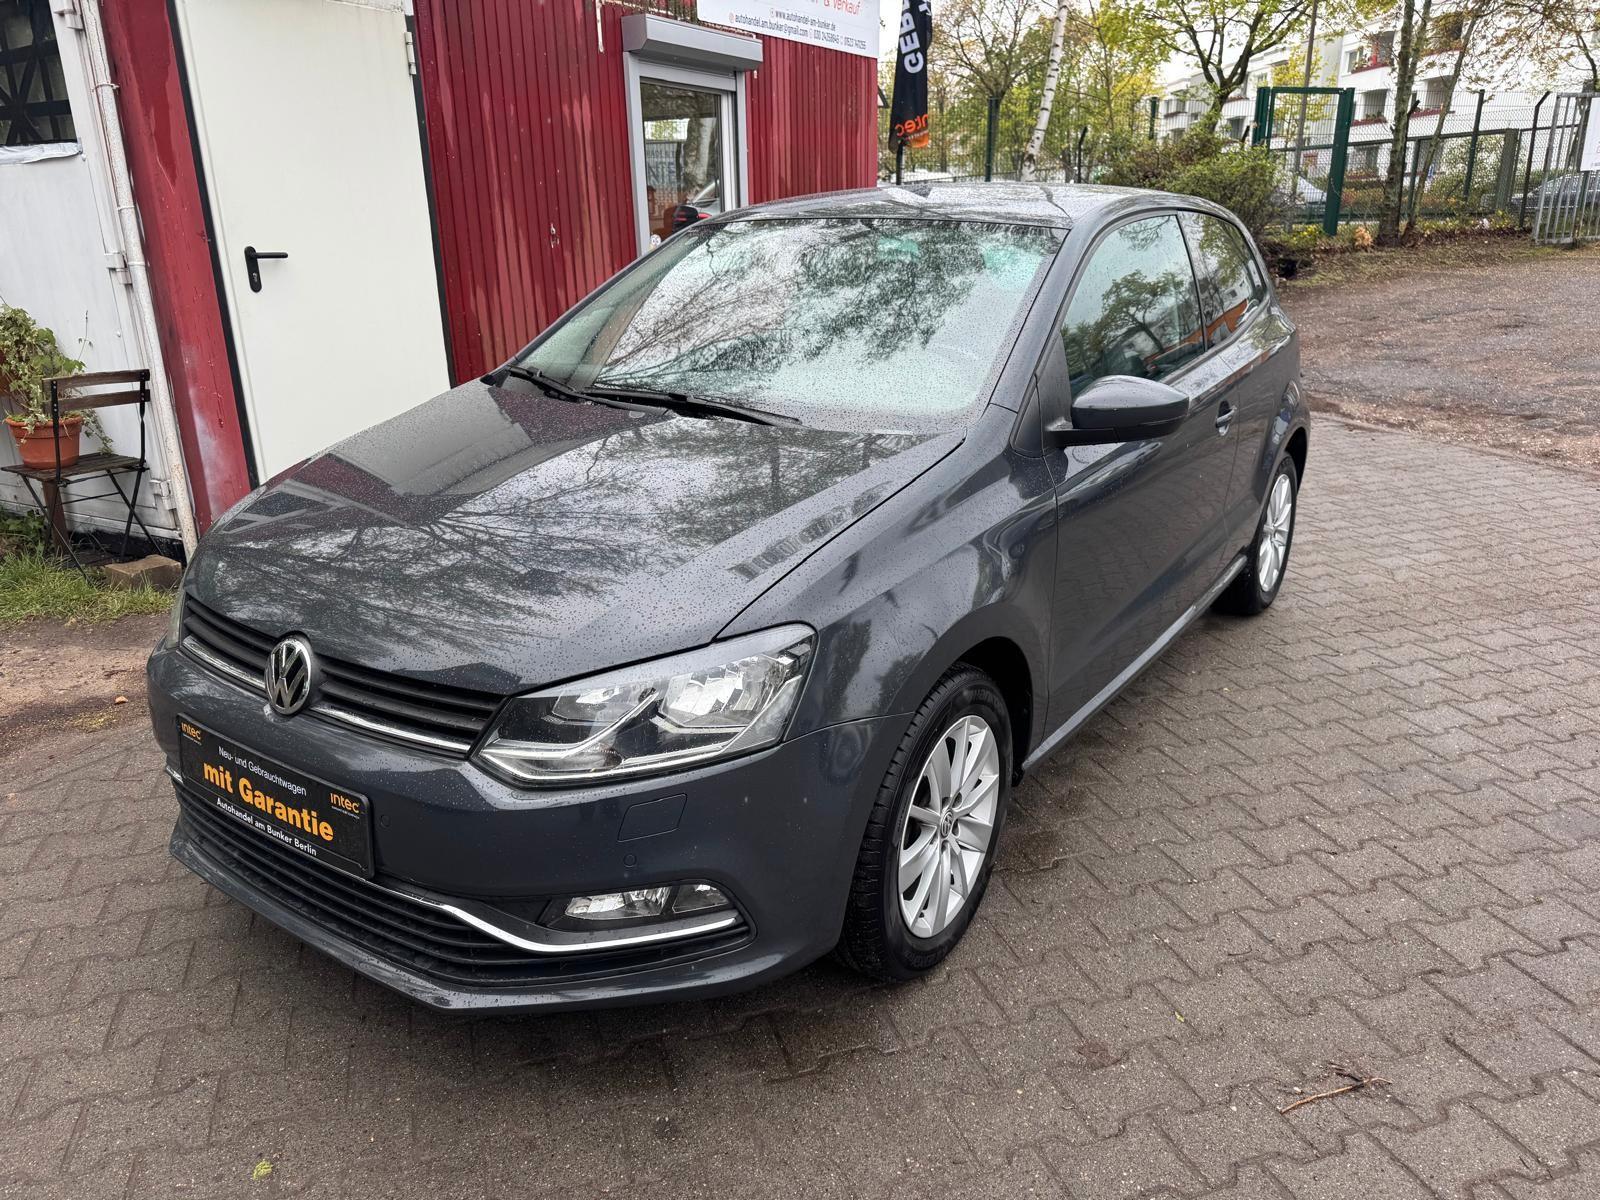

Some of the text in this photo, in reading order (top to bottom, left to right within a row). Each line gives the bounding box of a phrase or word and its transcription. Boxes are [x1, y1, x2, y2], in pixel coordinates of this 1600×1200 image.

[218, 746, 307, 797] Neu- und Gebrauchtwagen
[203, 762, 334, 841] mit Garantie
[216, 797, 317, 856] Autohandel am Bunker Berlin
[330, 792, 360, 814] intec
